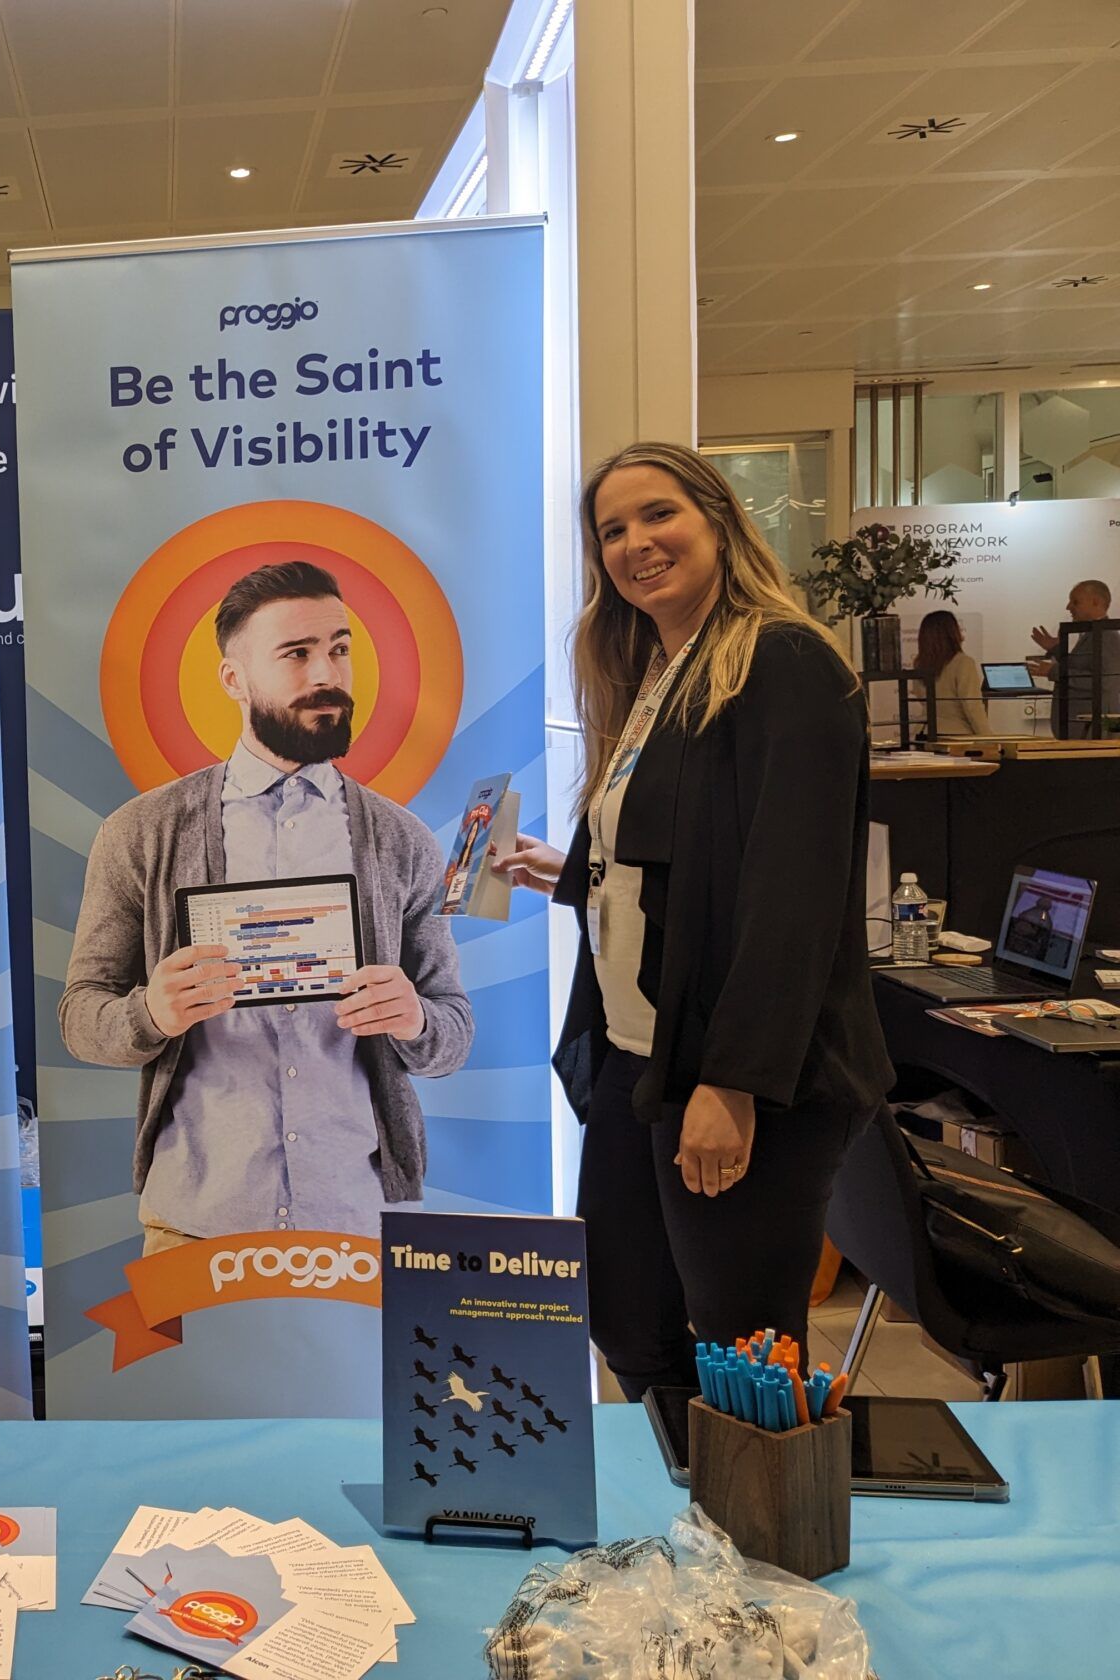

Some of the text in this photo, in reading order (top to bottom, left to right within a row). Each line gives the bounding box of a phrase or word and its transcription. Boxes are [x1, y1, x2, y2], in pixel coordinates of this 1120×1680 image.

[220, 297, 318, 331] proggio
[110, 348, 443, 407] Be the Saint
[122, 417, 431, 473] of Visibility
[903, 523, 983, 535] PROGRAM
[977, 554, 1001, 563] PPM
[210, 1242, 379, 1292] proggio
[390, 1244, 581, 1279] Time to Deliver
[449, 1307, 583, 1323] management approach revealed
[460, 1298, 569, 1313] An innovative new project
[183, 1600, 245, 1626] proggio
[244, 1656, 270, 1669] Alcon
